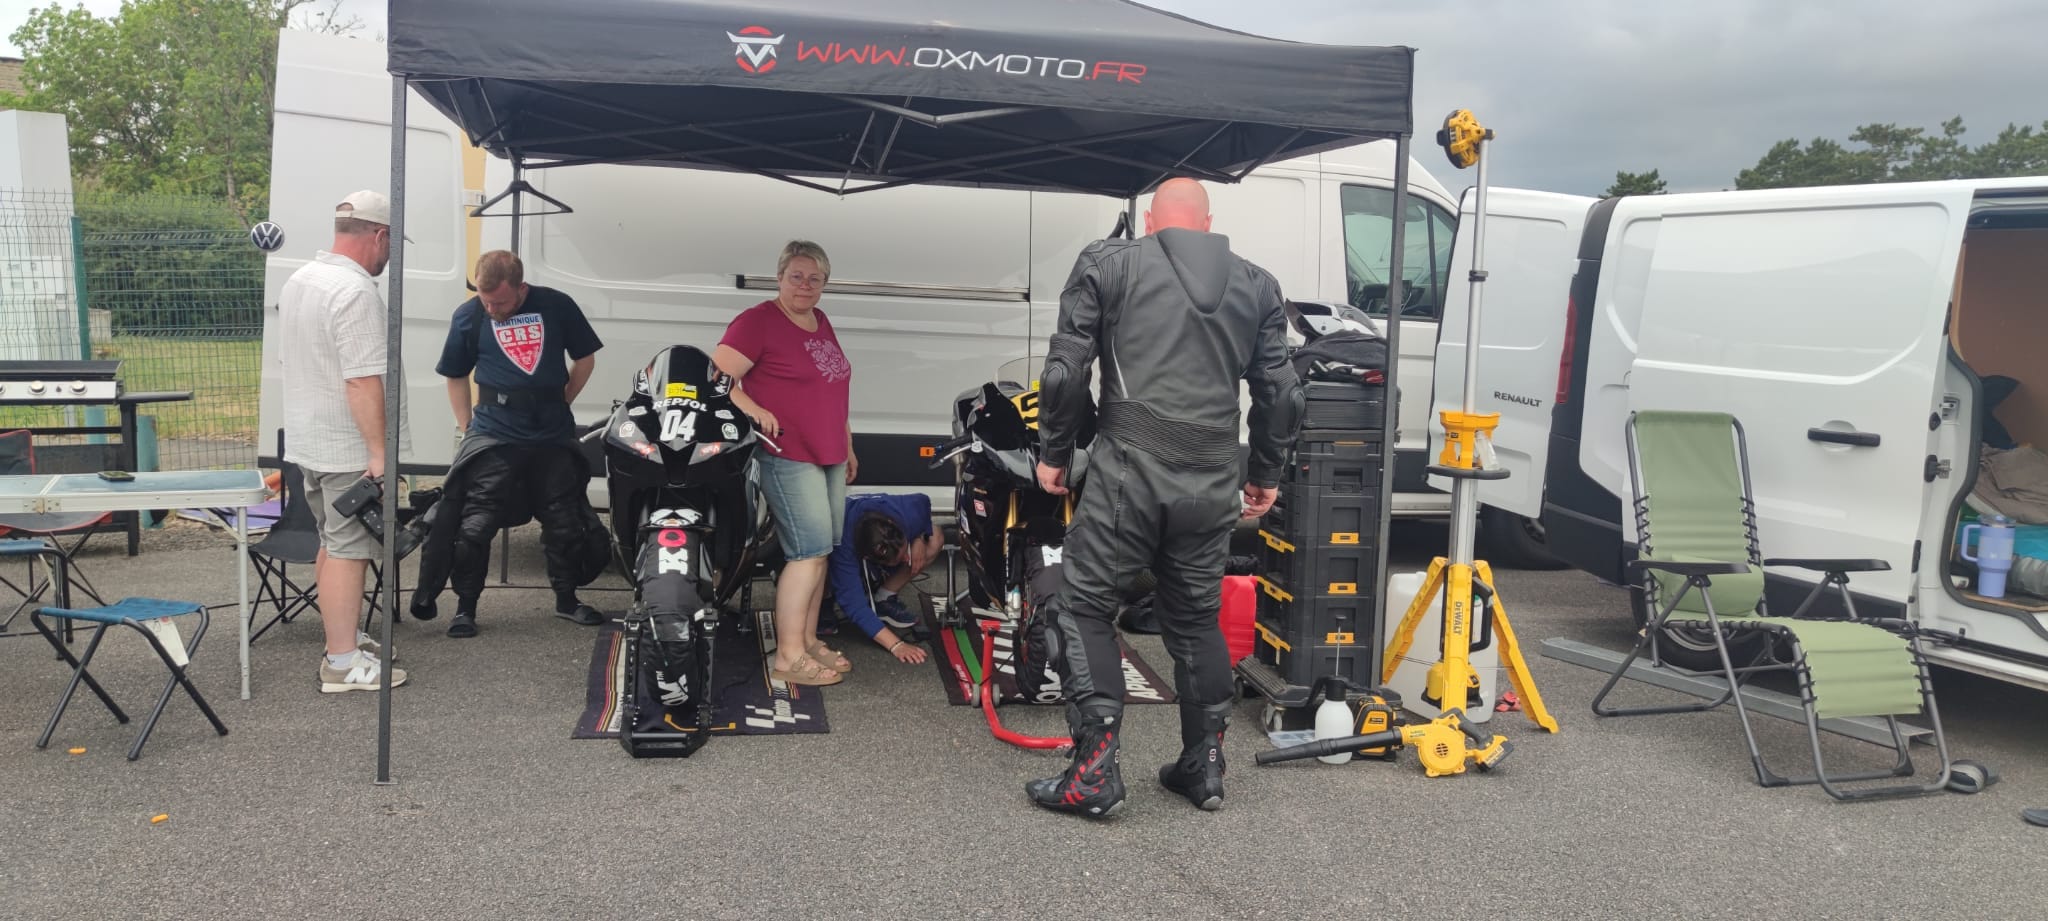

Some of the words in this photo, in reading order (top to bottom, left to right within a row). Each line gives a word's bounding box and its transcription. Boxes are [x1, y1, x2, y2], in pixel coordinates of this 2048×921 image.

[797, 41, 1147, 84] WWW.OXMOTO.FR
[499, 325, 541, 343] CRS
[652, 398, 708, 412] REPSOL
[1494, 391, 1542, 407] RENAULT
[660, 409, 697, 441] 04
[1453, 601, 1463, 635] DEWALT
